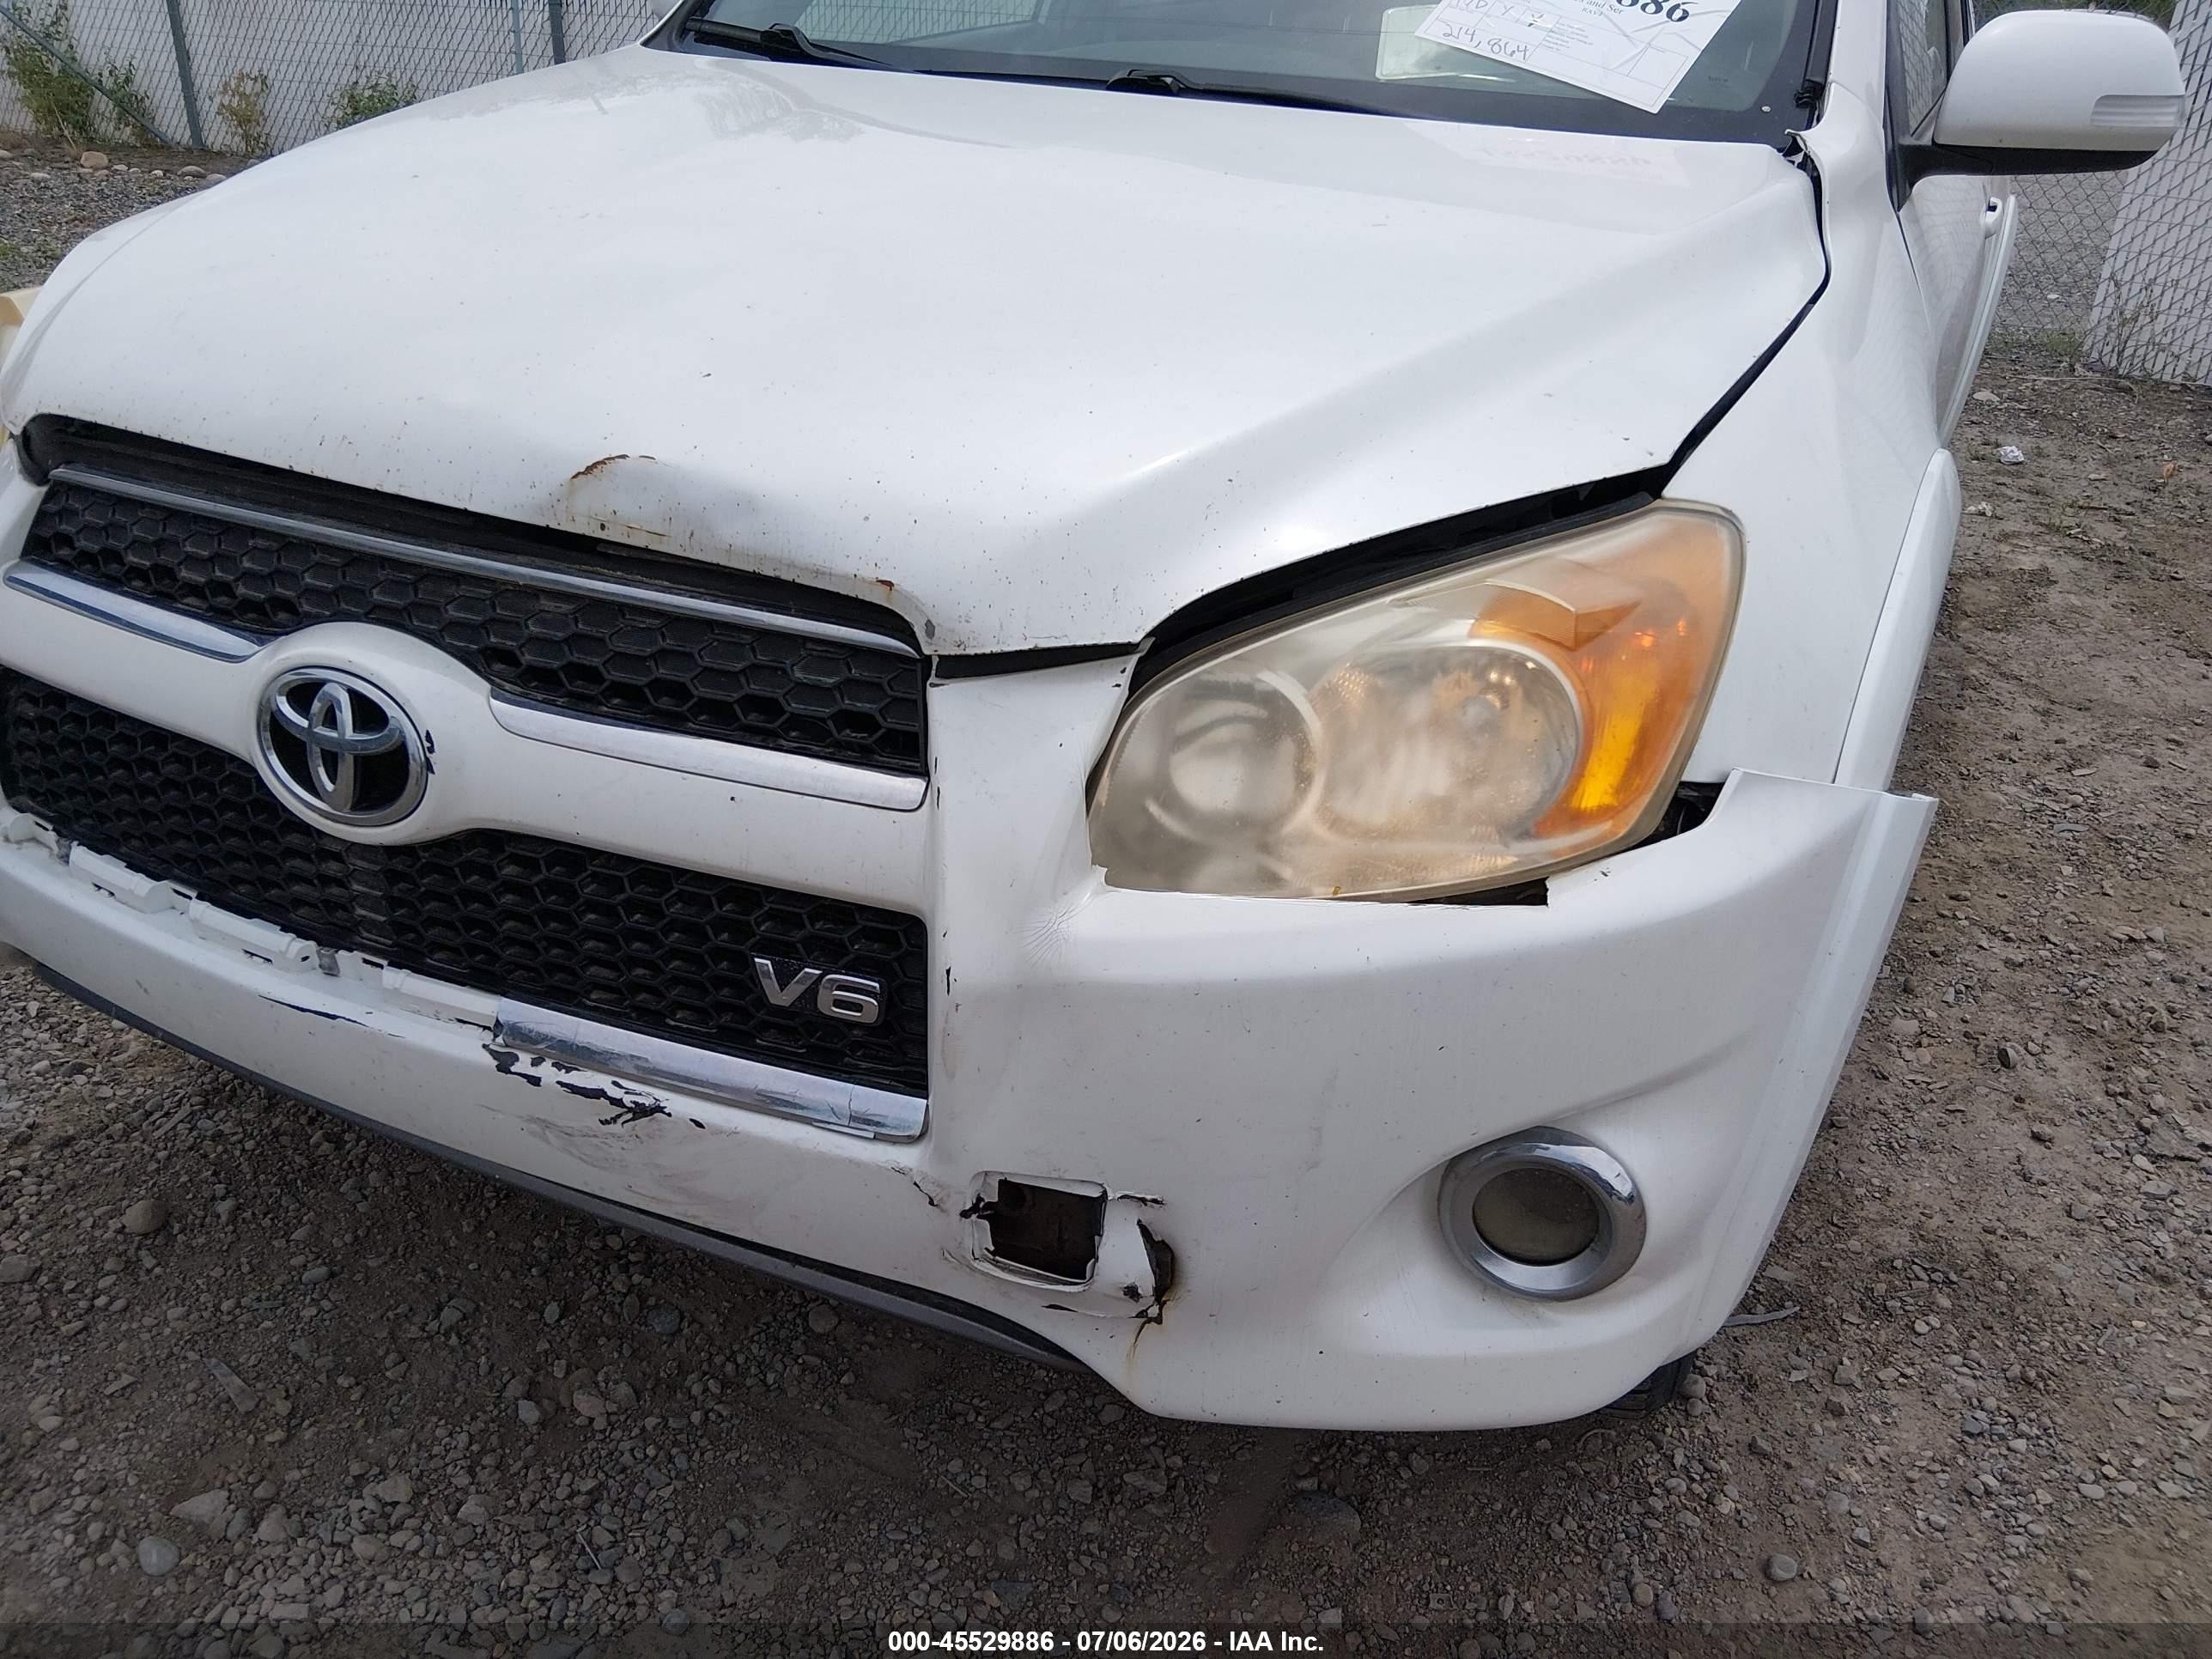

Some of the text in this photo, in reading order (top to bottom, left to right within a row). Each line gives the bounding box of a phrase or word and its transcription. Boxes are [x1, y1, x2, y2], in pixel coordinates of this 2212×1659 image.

[1615, 0, 1698, 22] 86
[1442, 21, 1530, 61] 214,864
[754, 957, 880, 1024] V6
